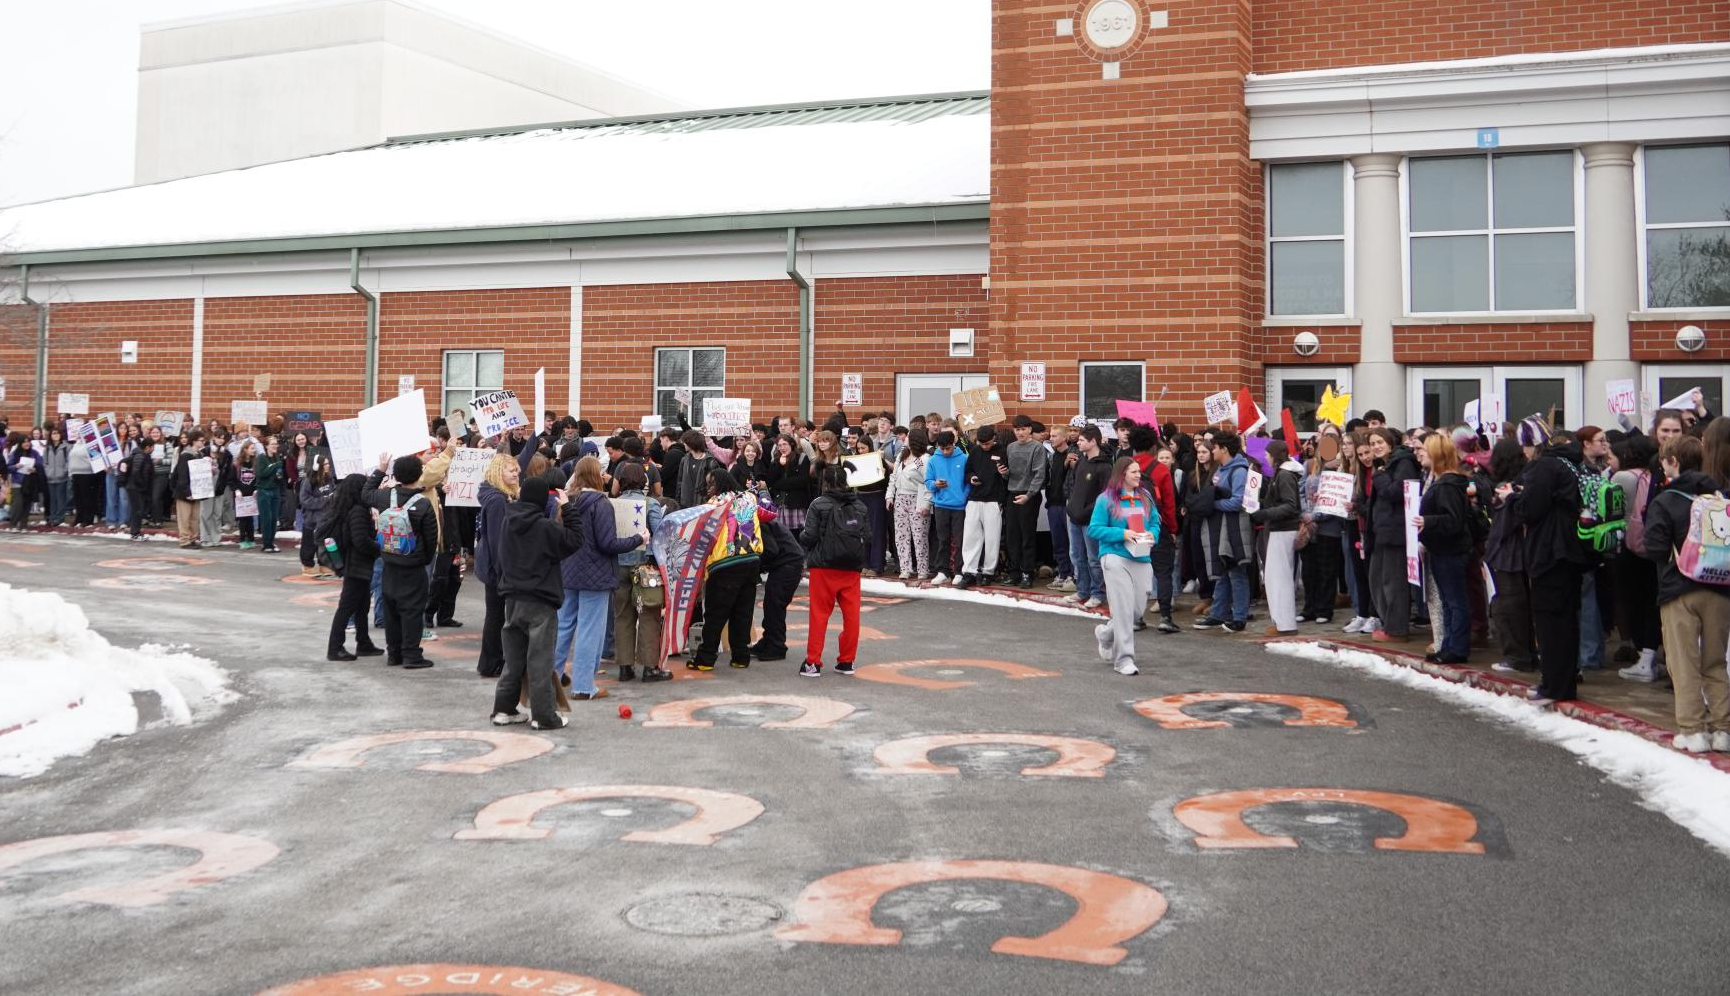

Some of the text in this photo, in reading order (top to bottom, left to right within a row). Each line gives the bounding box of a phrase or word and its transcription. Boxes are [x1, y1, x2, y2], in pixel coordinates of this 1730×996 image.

[1092, 15, 1131, 32] 1961
[1028, 365, 1038, 373] NO
[848, 375, 857, 383] NO
[1022, 373, 1044, 381] PARKING
[843, 382, 861, 390] PARKING
[469, 396, 489, 410] YOU
[482, 401, 510, 415] PRO LIFE
[1606, 390, 1635, 415] NAZIS
[295, 412, 310, 421] NO
[491, 410, 506, 421] AND
[486, 416, 520, 435] PRO ICE
[450, 481, 475, 499] NAZI
[1701, 566, 1730, 577] HELLO
[1698, 573, 1728, 582] KITTY
